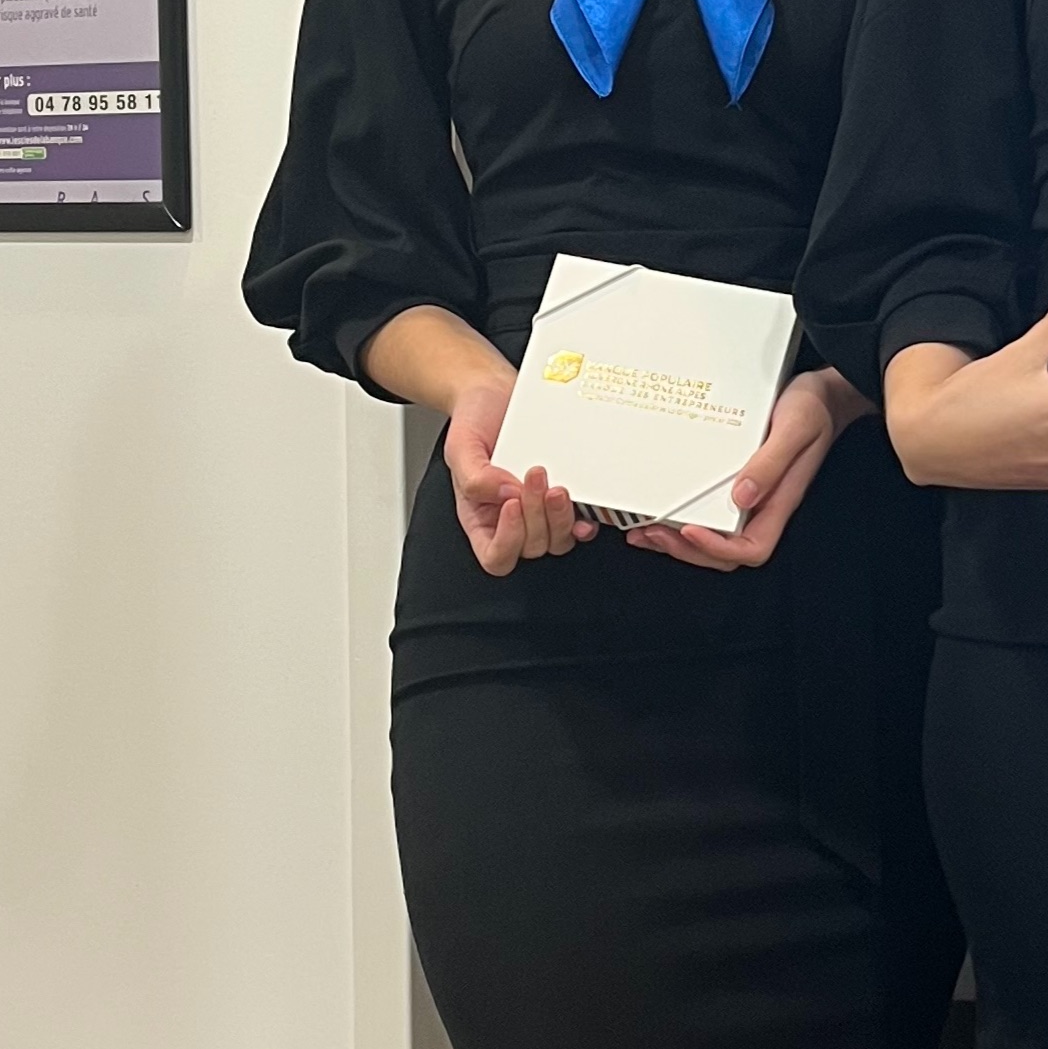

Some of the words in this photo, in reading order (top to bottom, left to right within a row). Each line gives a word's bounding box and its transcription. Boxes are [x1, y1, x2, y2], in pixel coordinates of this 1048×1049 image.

[25, 5, 59, 22] aggravé
[61, 6, 72, 19] de
[74, 3, 98, 18] santé
[35, 96, 54, 112] 04
[61, 95, 82, 112] 78
[88, 94, 109, 111] 95
[116, 94, 137, 110] 58
[653, 393, 746, 417] ENTREPRENEURS
